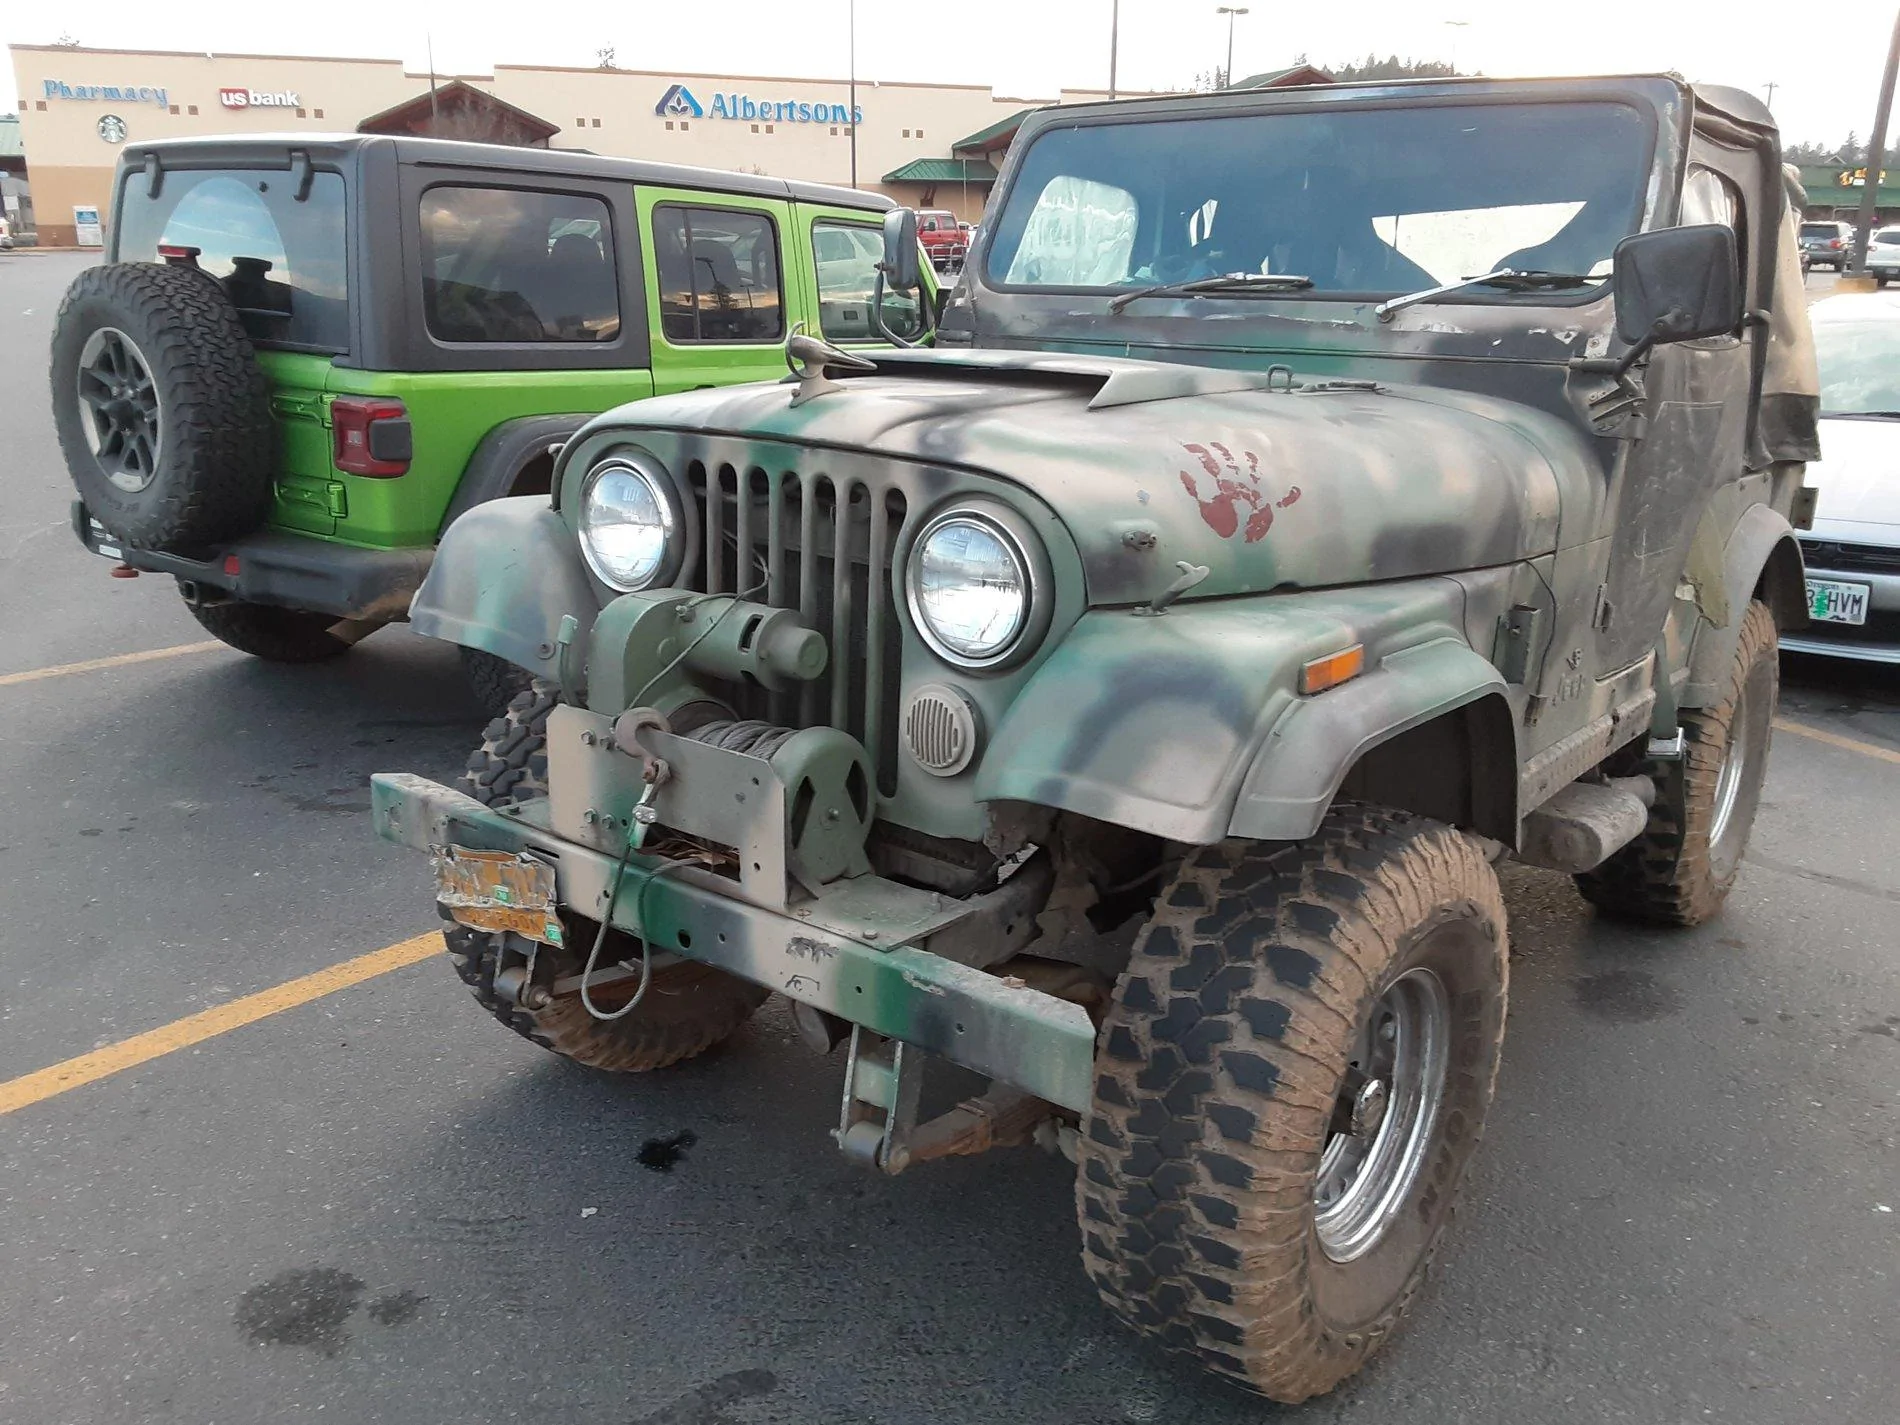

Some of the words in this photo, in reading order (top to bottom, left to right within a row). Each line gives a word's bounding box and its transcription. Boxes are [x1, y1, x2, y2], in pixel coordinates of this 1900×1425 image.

[43, 79, 168, 109] Pharmacy
[708, 92, 864, 124] Albertsons
[1827, 590, 1864, 616] HVM
